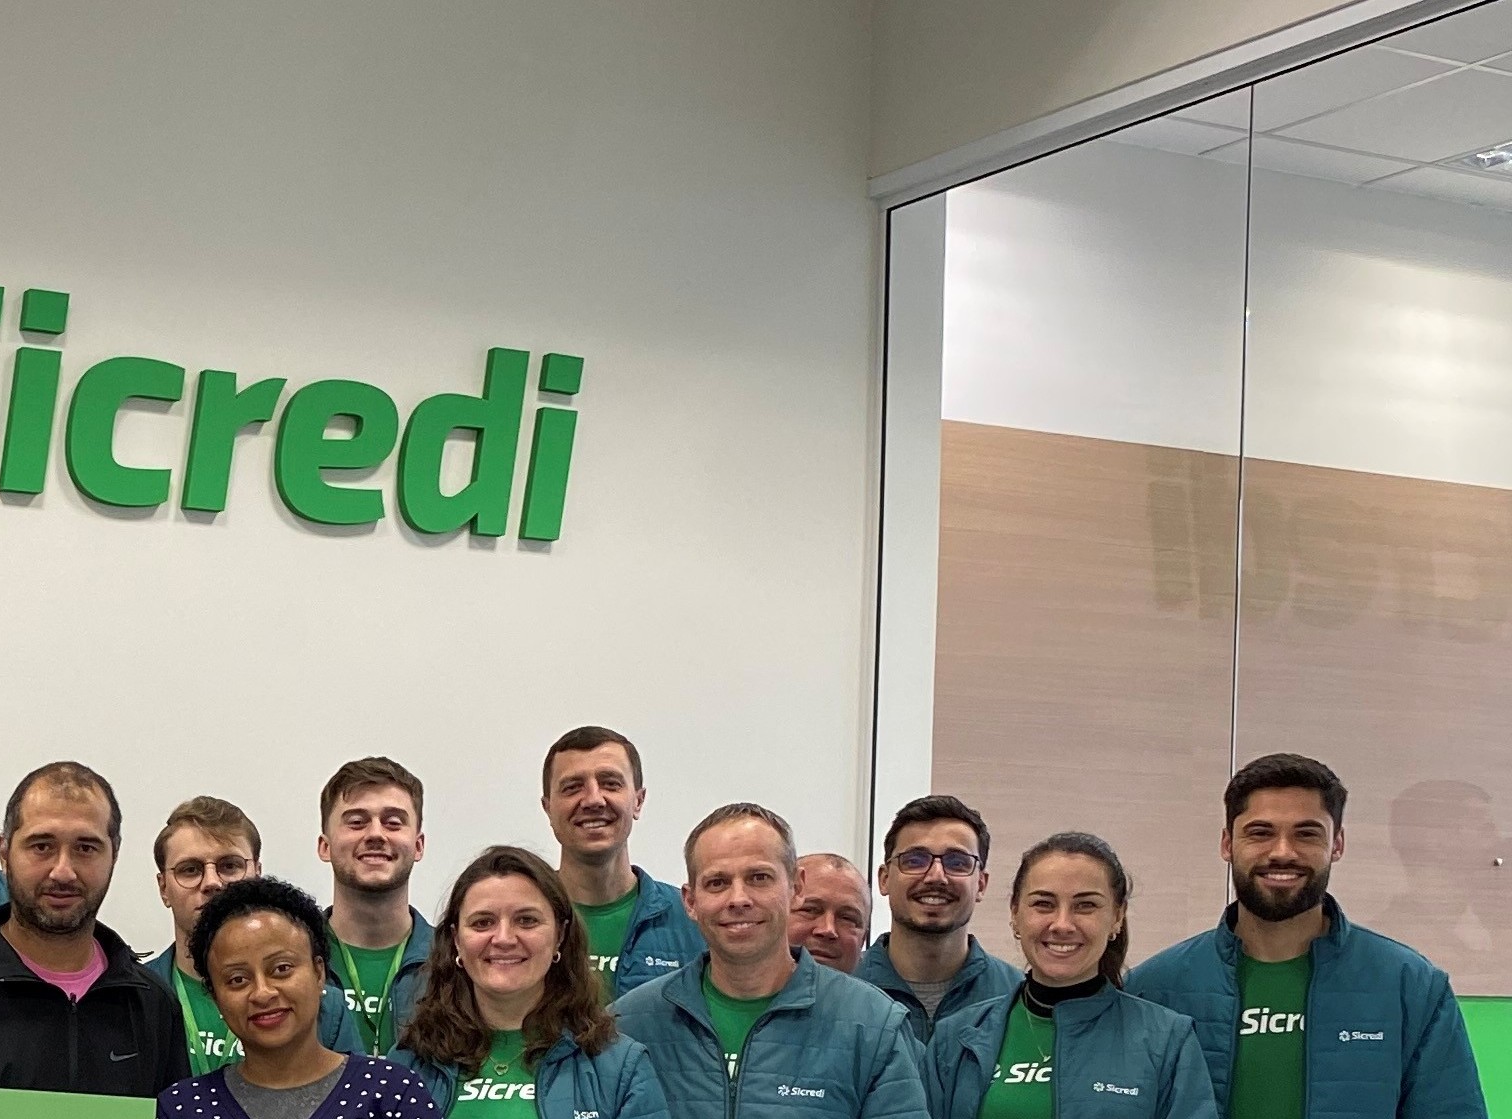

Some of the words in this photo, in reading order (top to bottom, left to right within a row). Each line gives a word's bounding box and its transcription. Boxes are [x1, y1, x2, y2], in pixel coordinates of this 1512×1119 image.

[1239, 1007, 1305, 1035] Sicr
[457, 1078, 536, 1101] Sicre
[790, 1086, 826, 1098] Sicredi
[1105, 1083, 1139, 1096] Sicredi
